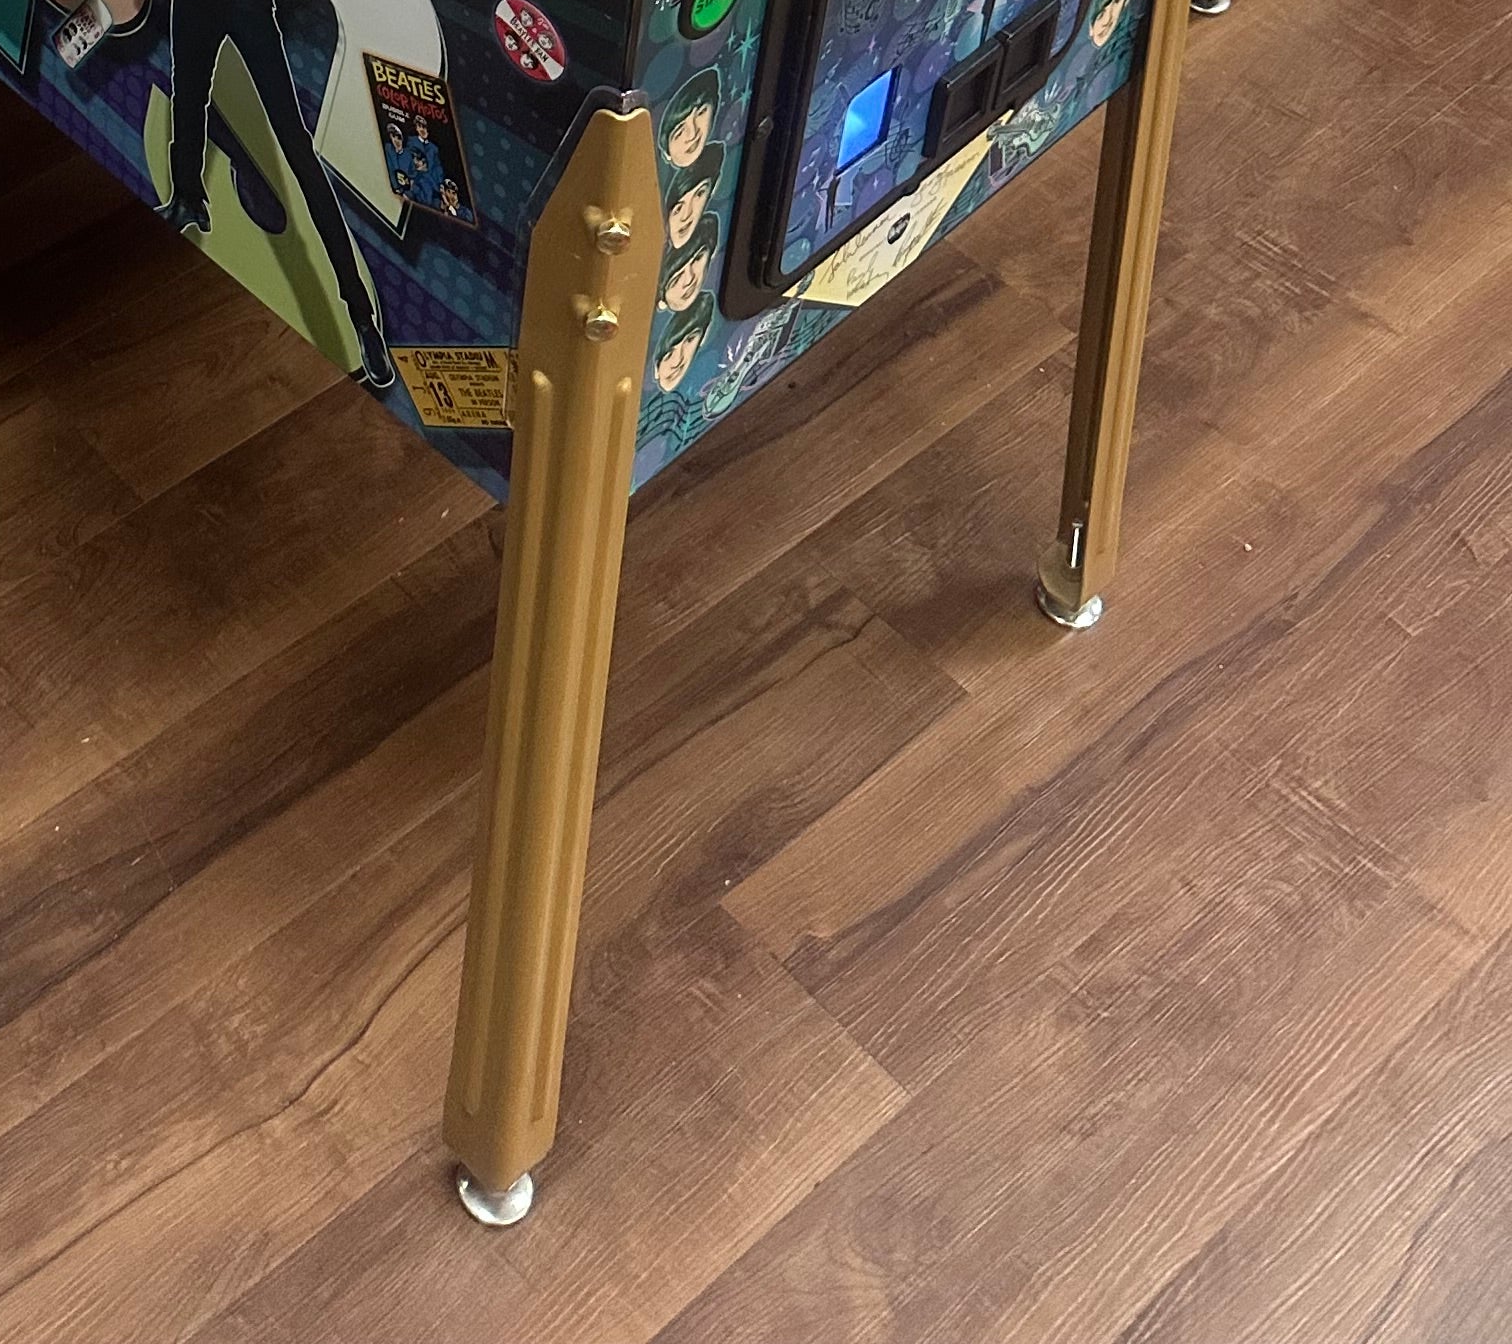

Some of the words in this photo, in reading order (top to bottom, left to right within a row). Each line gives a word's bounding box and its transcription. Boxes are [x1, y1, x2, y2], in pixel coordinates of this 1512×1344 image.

[534, 42, 549, 63] FAN
[371, 61, 446, 106] BEATLES
[377, 83, 409, 109] COLOR
[410, 96, 449, 125] PHOTOS
[429, 381, 454, 409] 13
